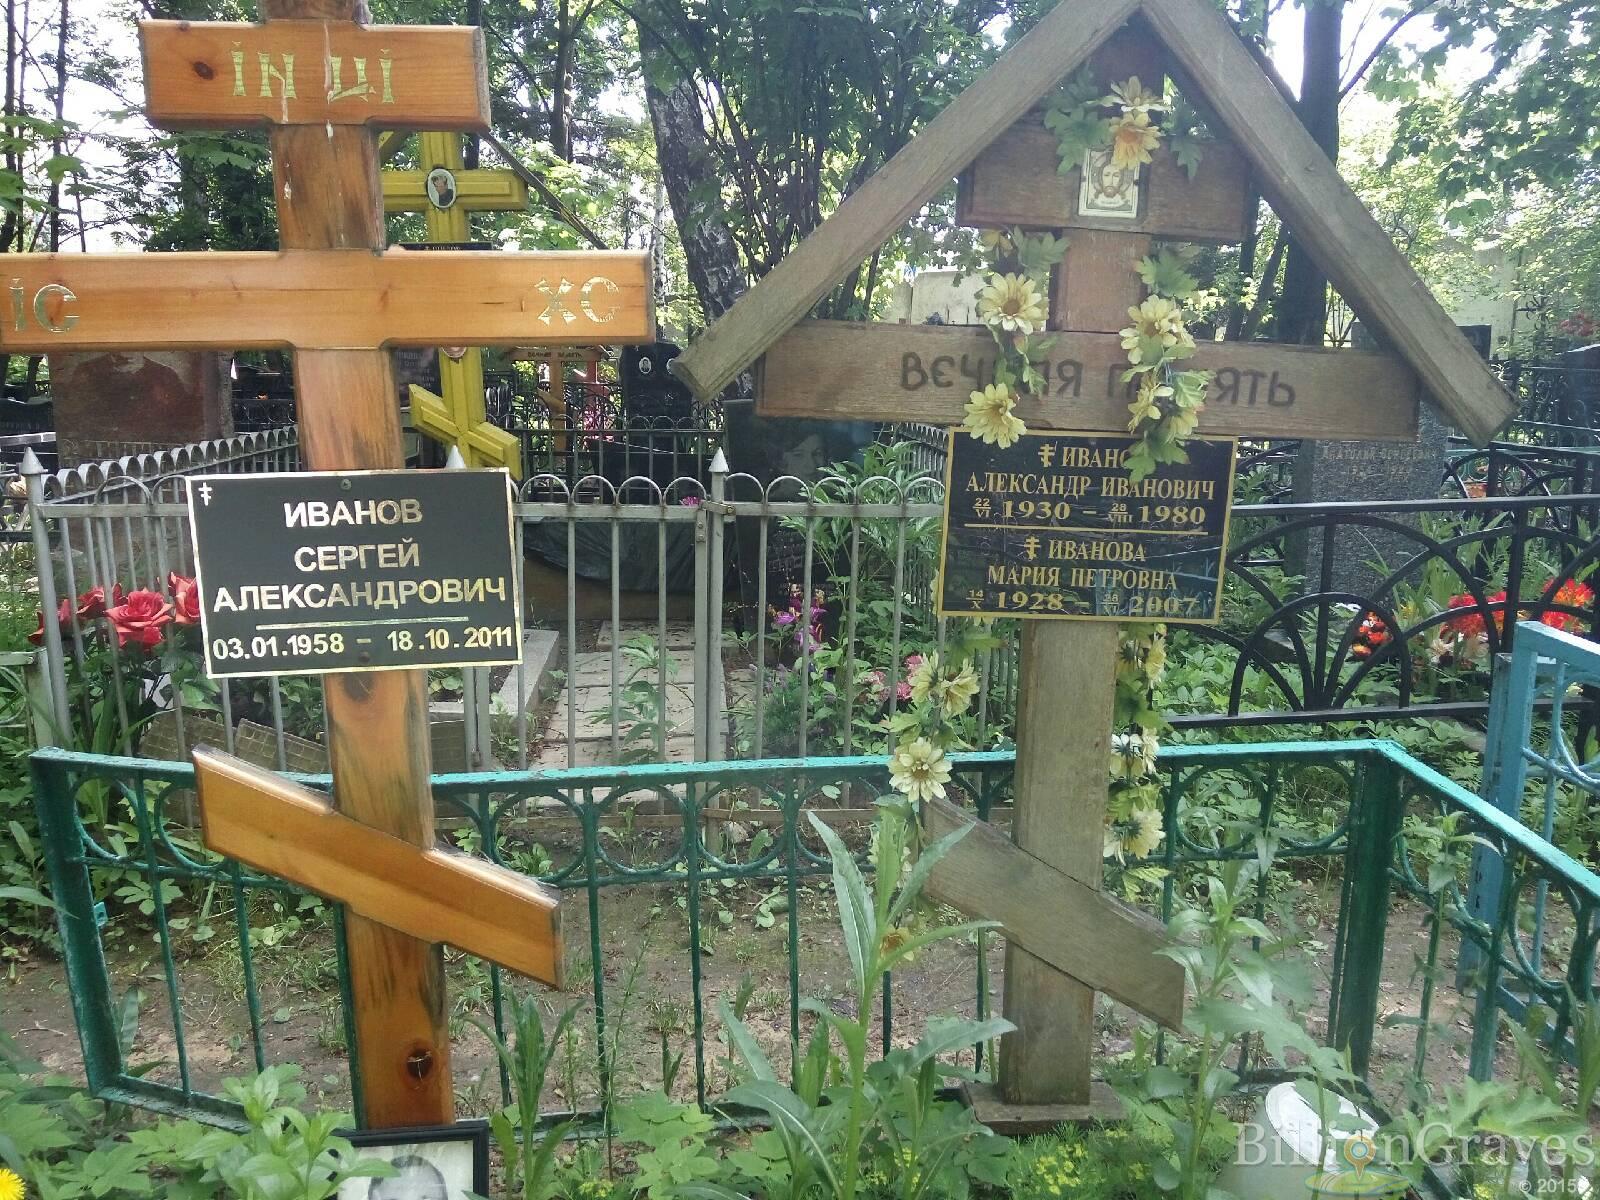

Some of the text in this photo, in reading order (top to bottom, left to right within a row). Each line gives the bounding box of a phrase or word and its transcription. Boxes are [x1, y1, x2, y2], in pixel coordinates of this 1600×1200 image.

[1107, 364, 1296, 408] ПЯТЬ
[966, 472, 1216, 500] АЛЕКСАНДР ИВАНОВИЧ
[284, 499, 423, 528] ИВАНОВ
[1002, 500, 1071, 520] 1930
[1138, 505, 1206, 525] 1980
[294, 537, 421, 572] СЕРГЕЙ
[1048, 539, 1146, 562] ИВАНОВА
[987, 565, 1177, 590] МАРИЯ ПЕТРОВНА
[213, 577, 506, 613] АЛЕКСАНДРОВИЧ
[997, 591, 1063, 611] 1928
[213, 632, 345, 660] 03.01.1958
[387, 626, 513, 652] 18.10.2011
